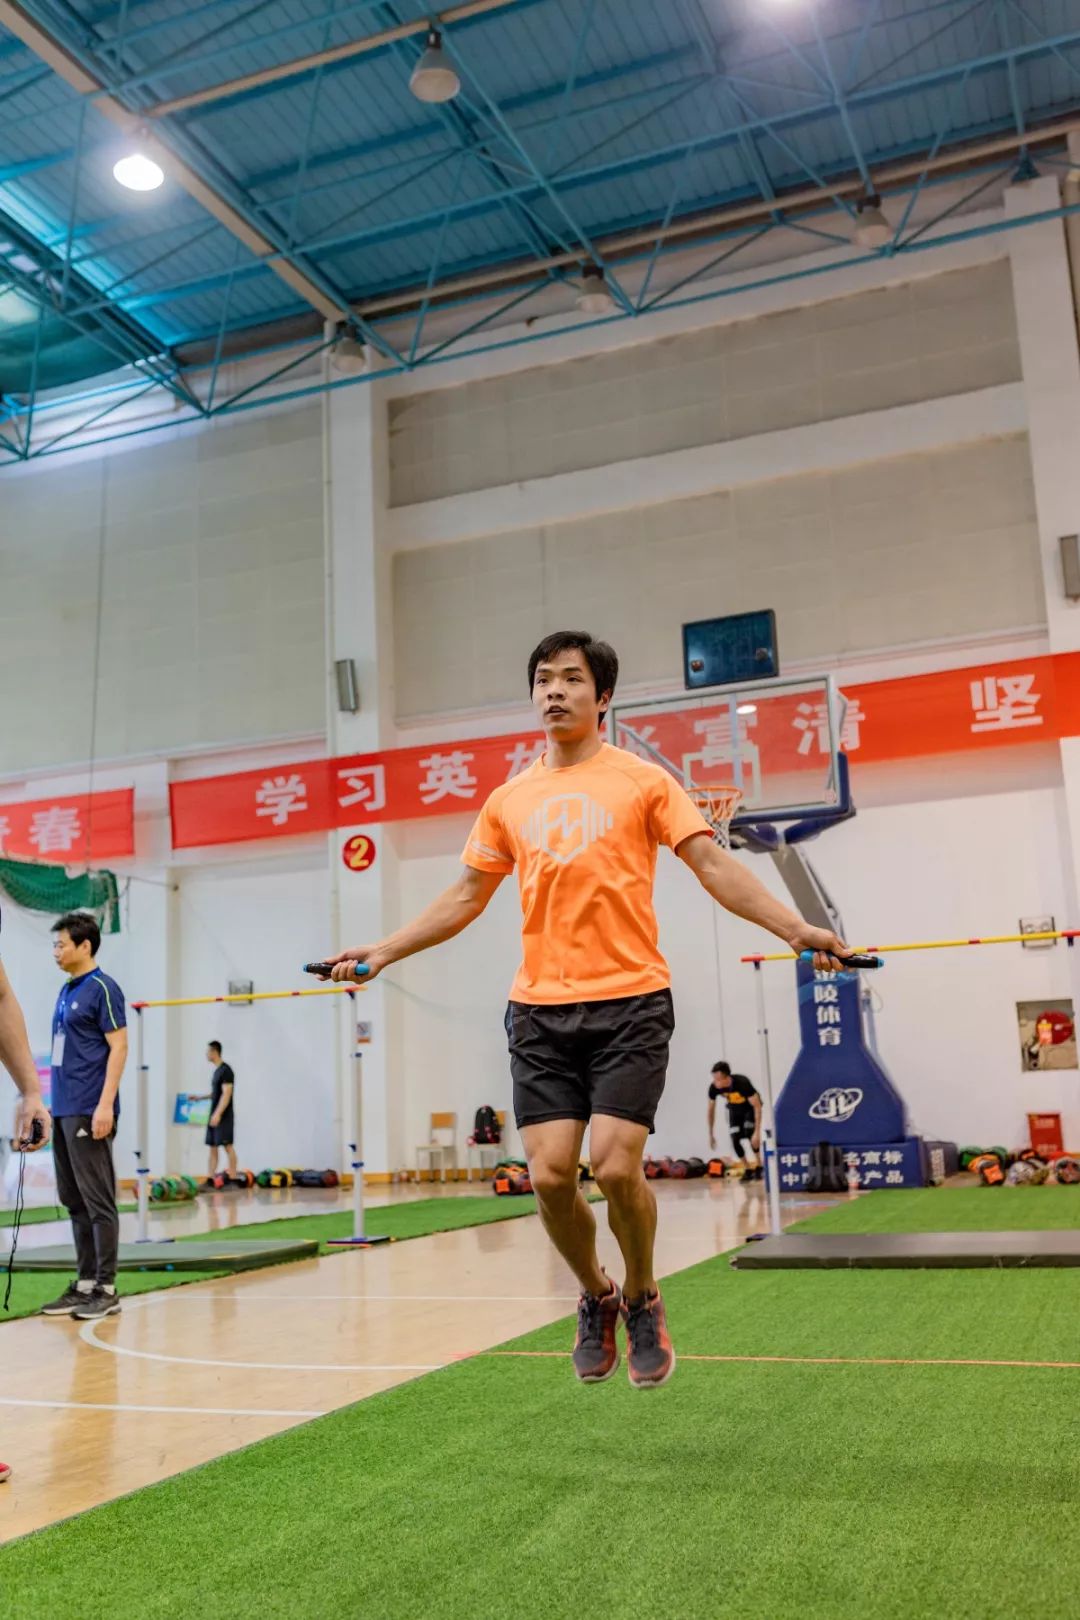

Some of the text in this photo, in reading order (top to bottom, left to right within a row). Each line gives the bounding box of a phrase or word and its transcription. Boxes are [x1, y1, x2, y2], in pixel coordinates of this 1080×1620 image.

[970, 674, 1044, 733] 坚
[0, 803, 82, 854] 春
[349, 838, 370, 868] 2
